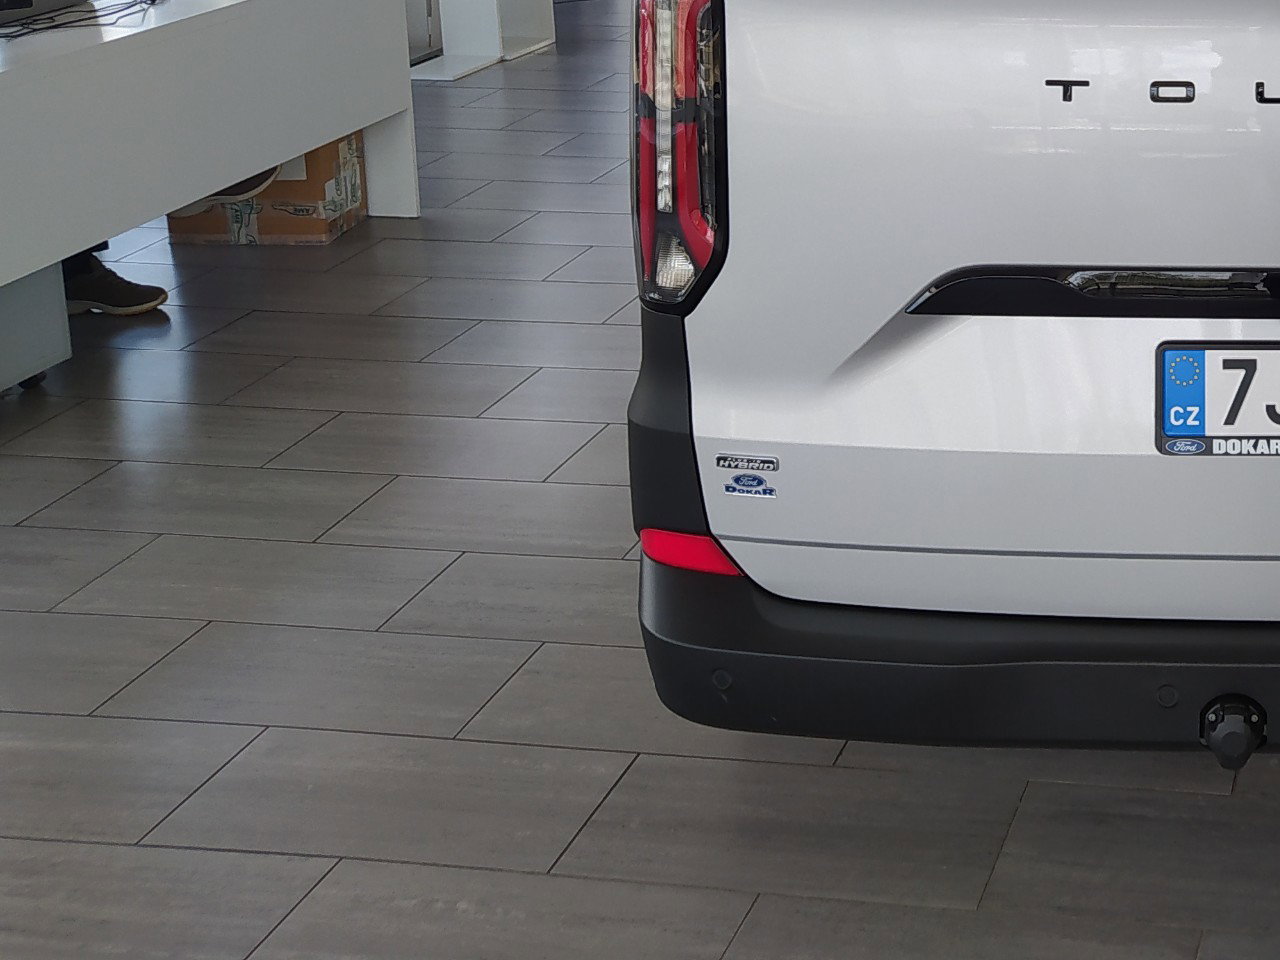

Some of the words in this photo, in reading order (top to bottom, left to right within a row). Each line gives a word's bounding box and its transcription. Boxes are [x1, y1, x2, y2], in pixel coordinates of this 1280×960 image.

[1169, 406, 1200, 426] CZ
[719, 459, 775, 472] HYBRID
[724, 485, 775, 496] DOKAR
